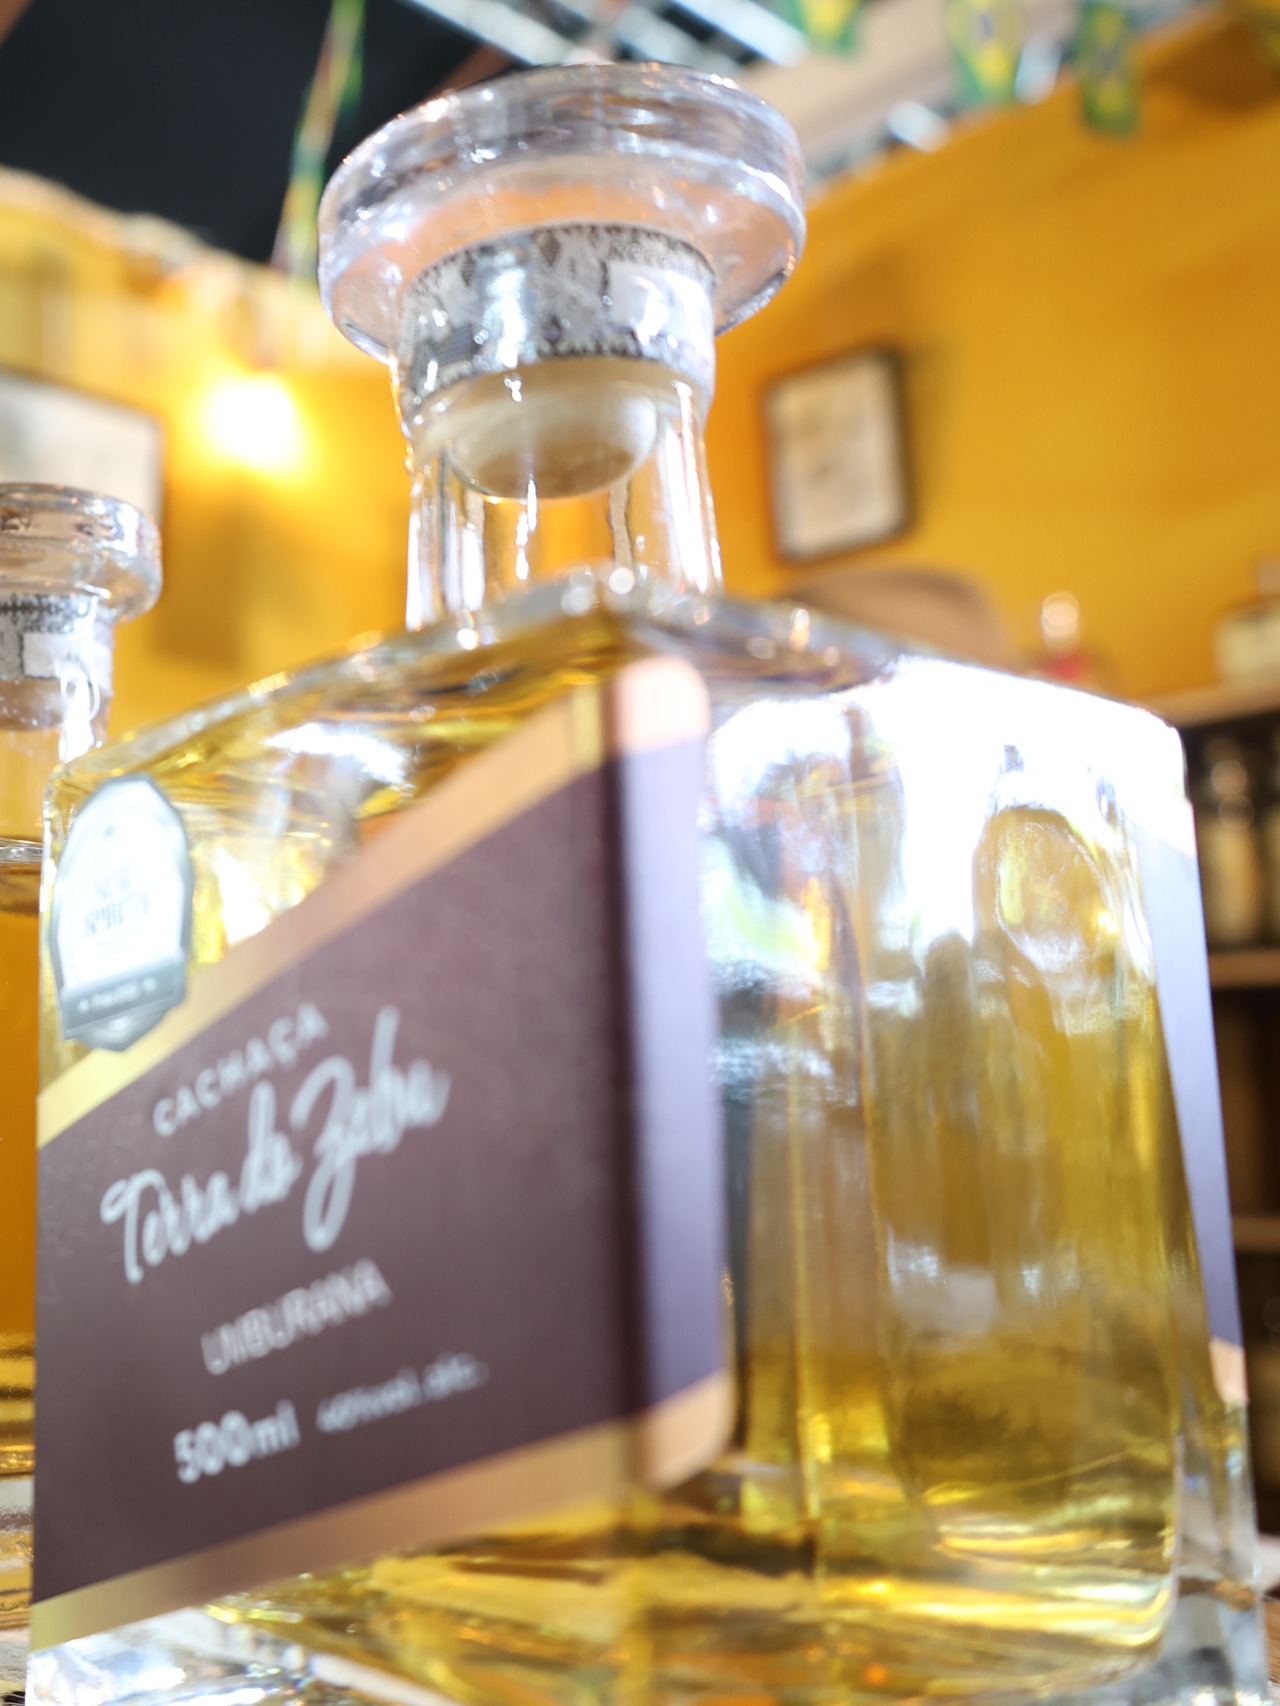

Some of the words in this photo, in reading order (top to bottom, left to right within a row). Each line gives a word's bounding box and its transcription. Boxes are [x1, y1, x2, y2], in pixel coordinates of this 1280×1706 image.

[152, 1000, 332, 1137] CACHAÇA
[99, 1167, 240, 1285] Terra
[240, 1080, 304, 1214] do
[290, 1004, 451, 1253] Zebu
[174, 1399, 301, 1485] 500ml
